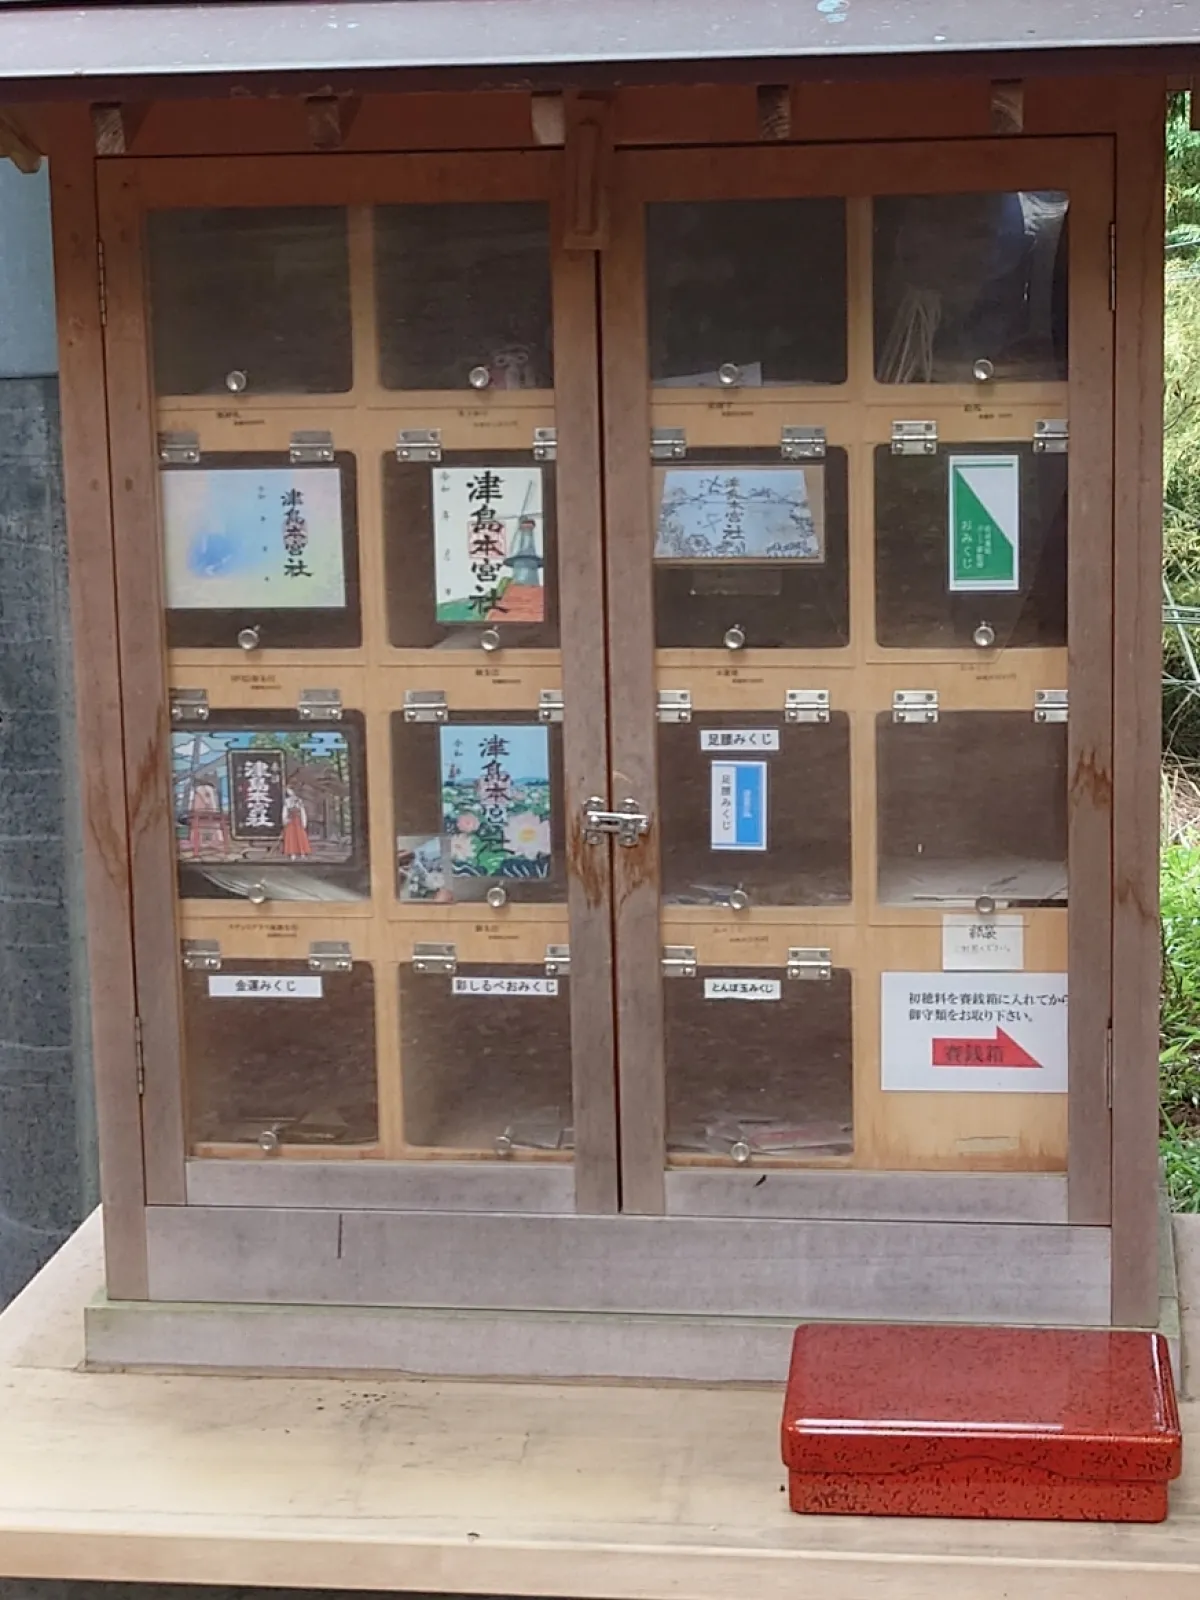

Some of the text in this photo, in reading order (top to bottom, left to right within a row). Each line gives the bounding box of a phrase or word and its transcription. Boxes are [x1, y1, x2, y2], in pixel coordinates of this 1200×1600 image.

[466, 470, 508, 614] 津島本宮社
[961, 520, 973, 570] おみくじ
[235, 979, 296, 992] 金運みくじ
[909, 1008, 1033, 1022] 御守類をお取り下さい。
